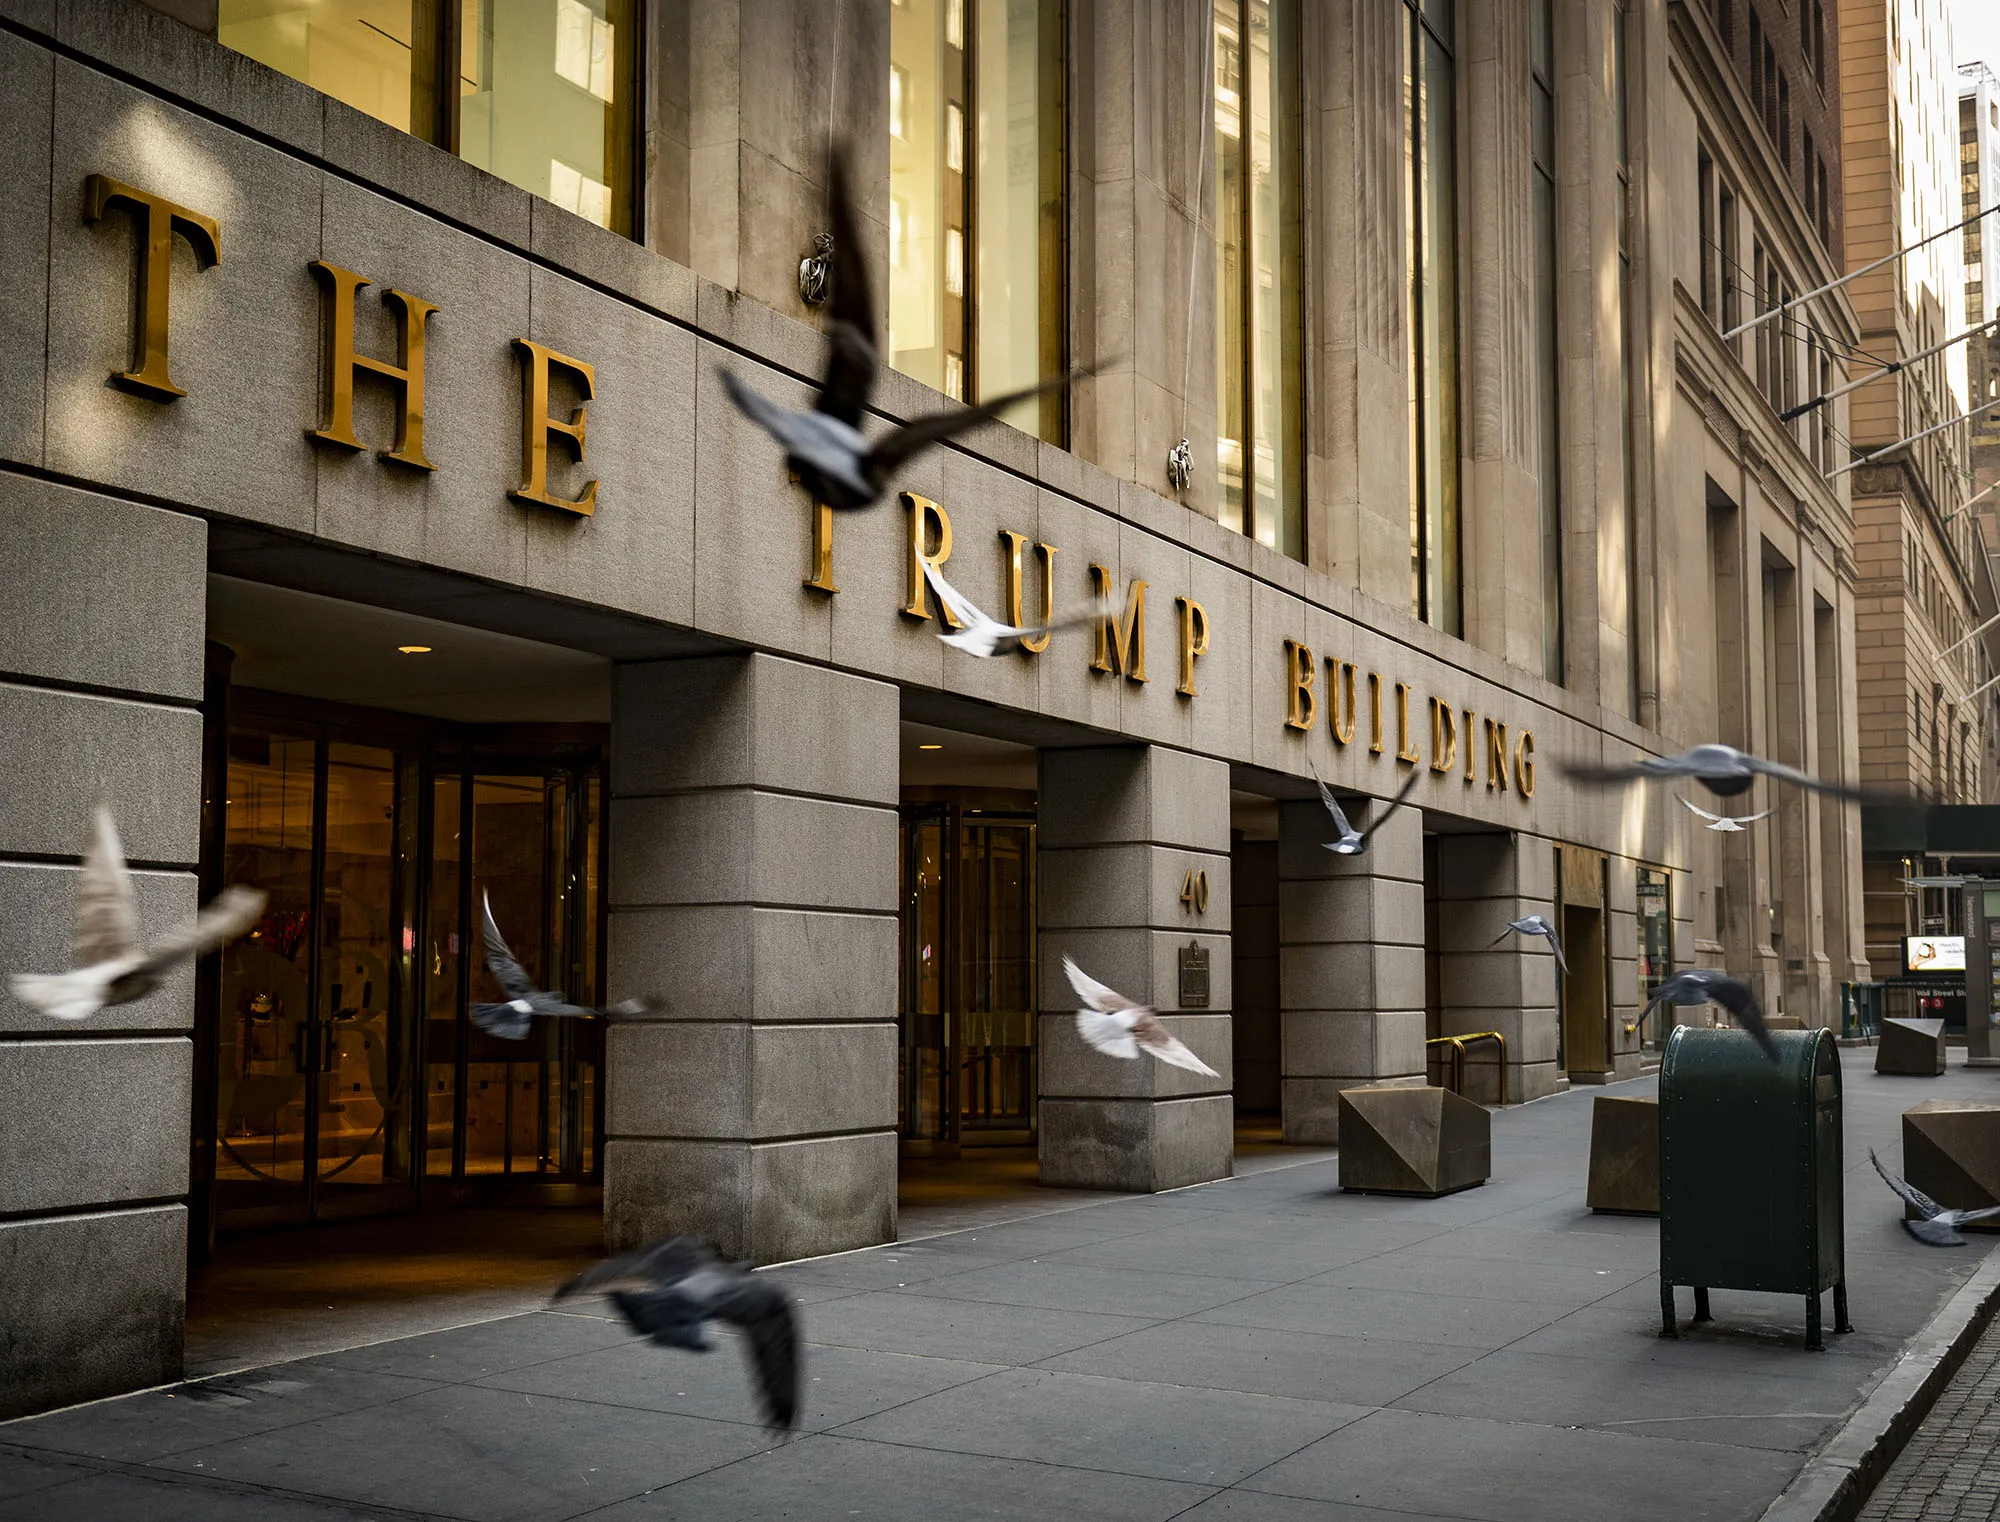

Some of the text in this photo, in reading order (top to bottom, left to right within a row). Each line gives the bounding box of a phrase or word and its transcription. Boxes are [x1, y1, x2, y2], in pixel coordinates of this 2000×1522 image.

[84, 173, 599, 517] THE
[1283, 639, 1536, 798] BUILDING
[1180, 869, 1208, 913] 40
[1916, 989, 1931, 997] Wall
[1932, 989, 1954, 997] Street
